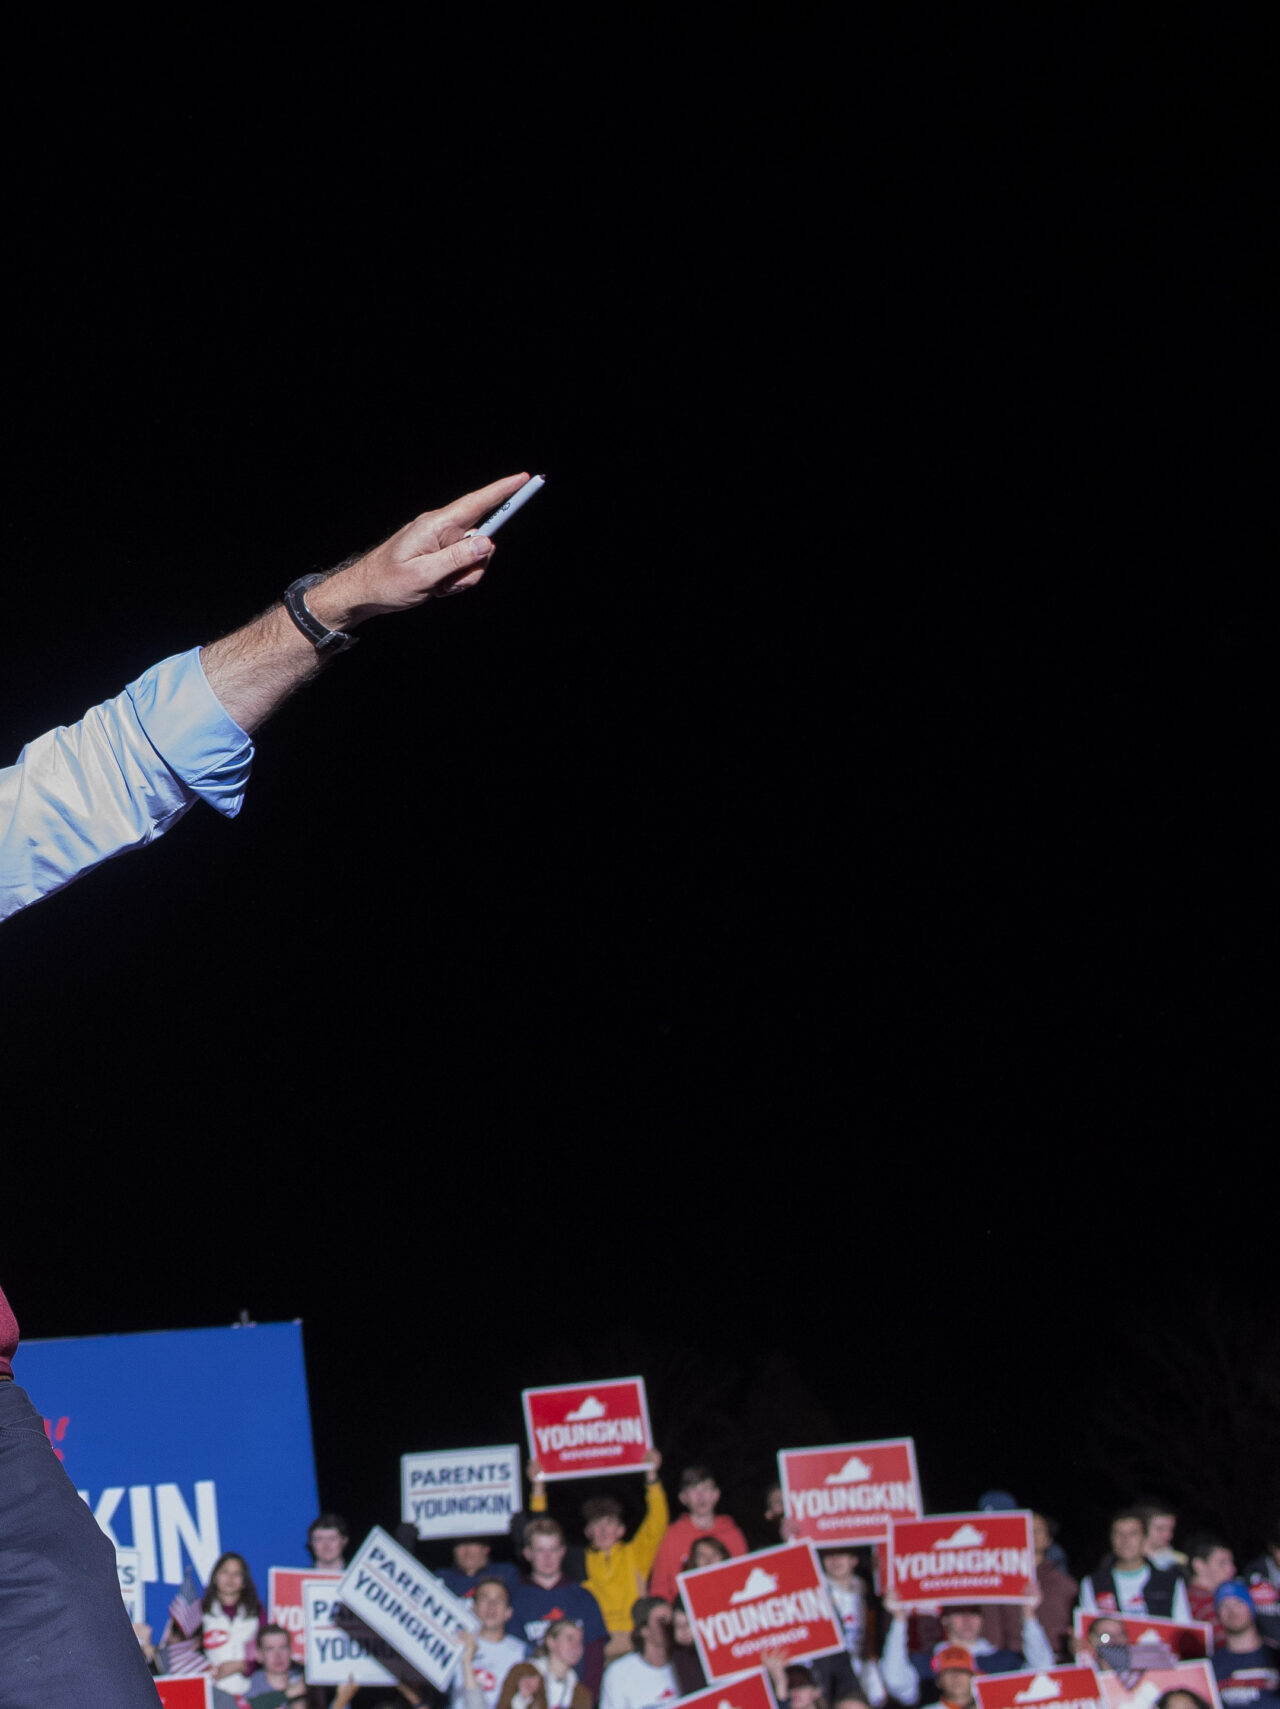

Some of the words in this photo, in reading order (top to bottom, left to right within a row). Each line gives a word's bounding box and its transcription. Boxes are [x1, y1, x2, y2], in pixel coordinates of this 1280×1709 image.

[535, 1417, 644, 1454] YOUNGKIN
[410, 1463, 511, 1488] PARENTS
[411, 1494, 513, 1522] YOUNGKIN
[789, 1481, 918, 1521] YOUNGKIN
[894, 1547, 1031, 1584] YOUNGKIN
[354, 1569, 453, 1670] YOUNGKIN
[696, 1584, 833, 1652] YOUNGKIN
